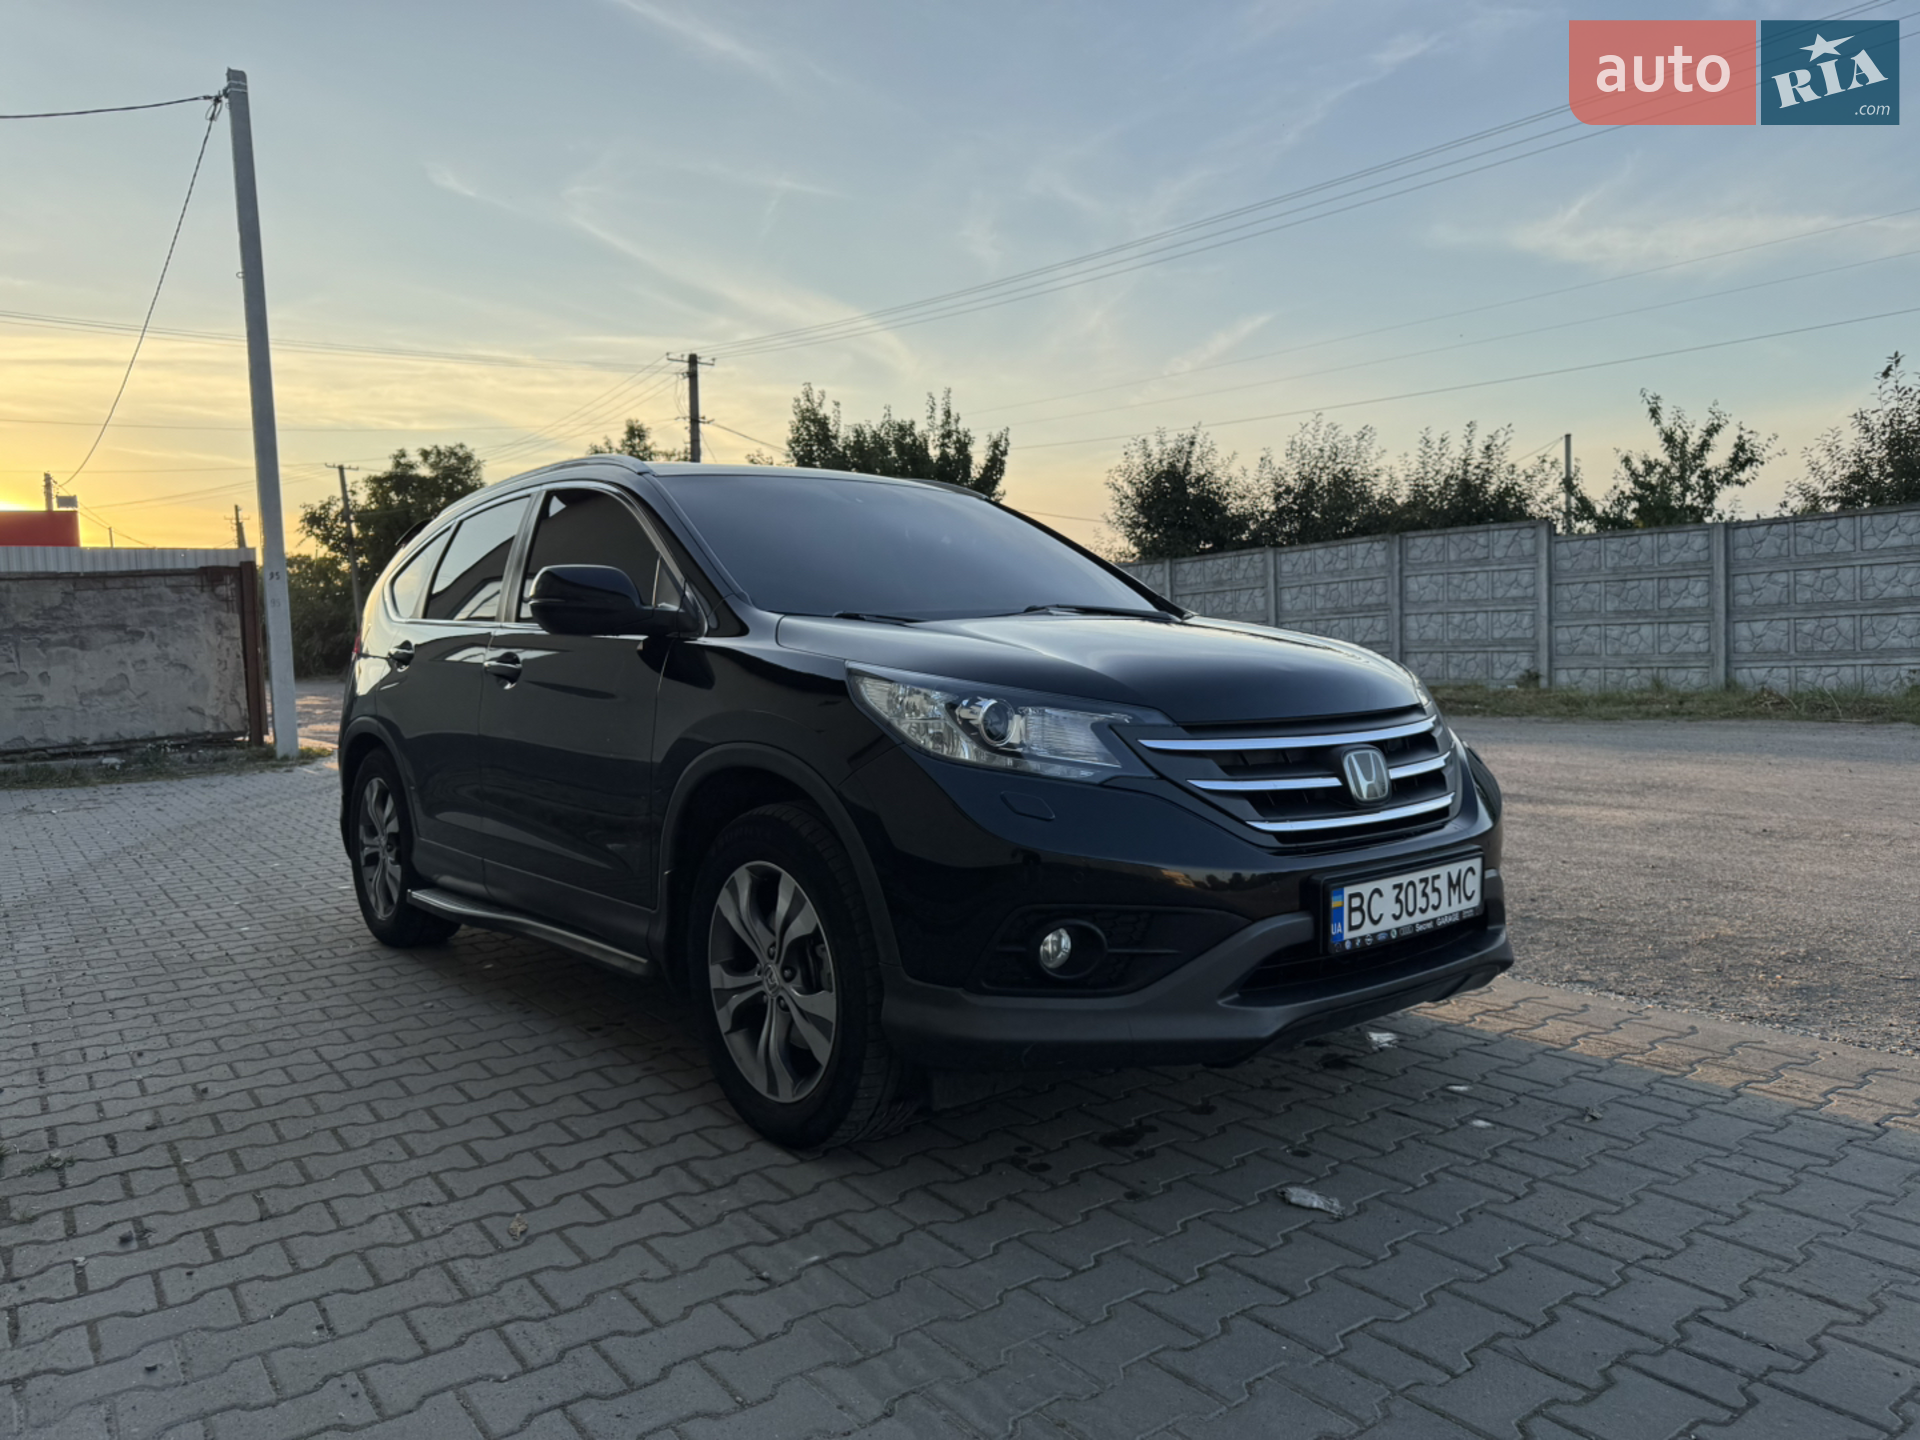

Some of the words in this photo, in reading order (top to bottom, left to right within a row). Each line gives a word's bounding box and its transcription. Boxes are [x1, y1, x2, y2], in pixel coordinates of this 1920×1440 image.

[1347, 887, 1384, 932] BC
[1391, 874, 1442, 921] 3035
[1447, 866, 1476, 907] MC
[1331, 922, 1342, 935] UA
[1415, 920, 1434, 932] Secret
[1436, 911, 1460, 926] GARAGE
